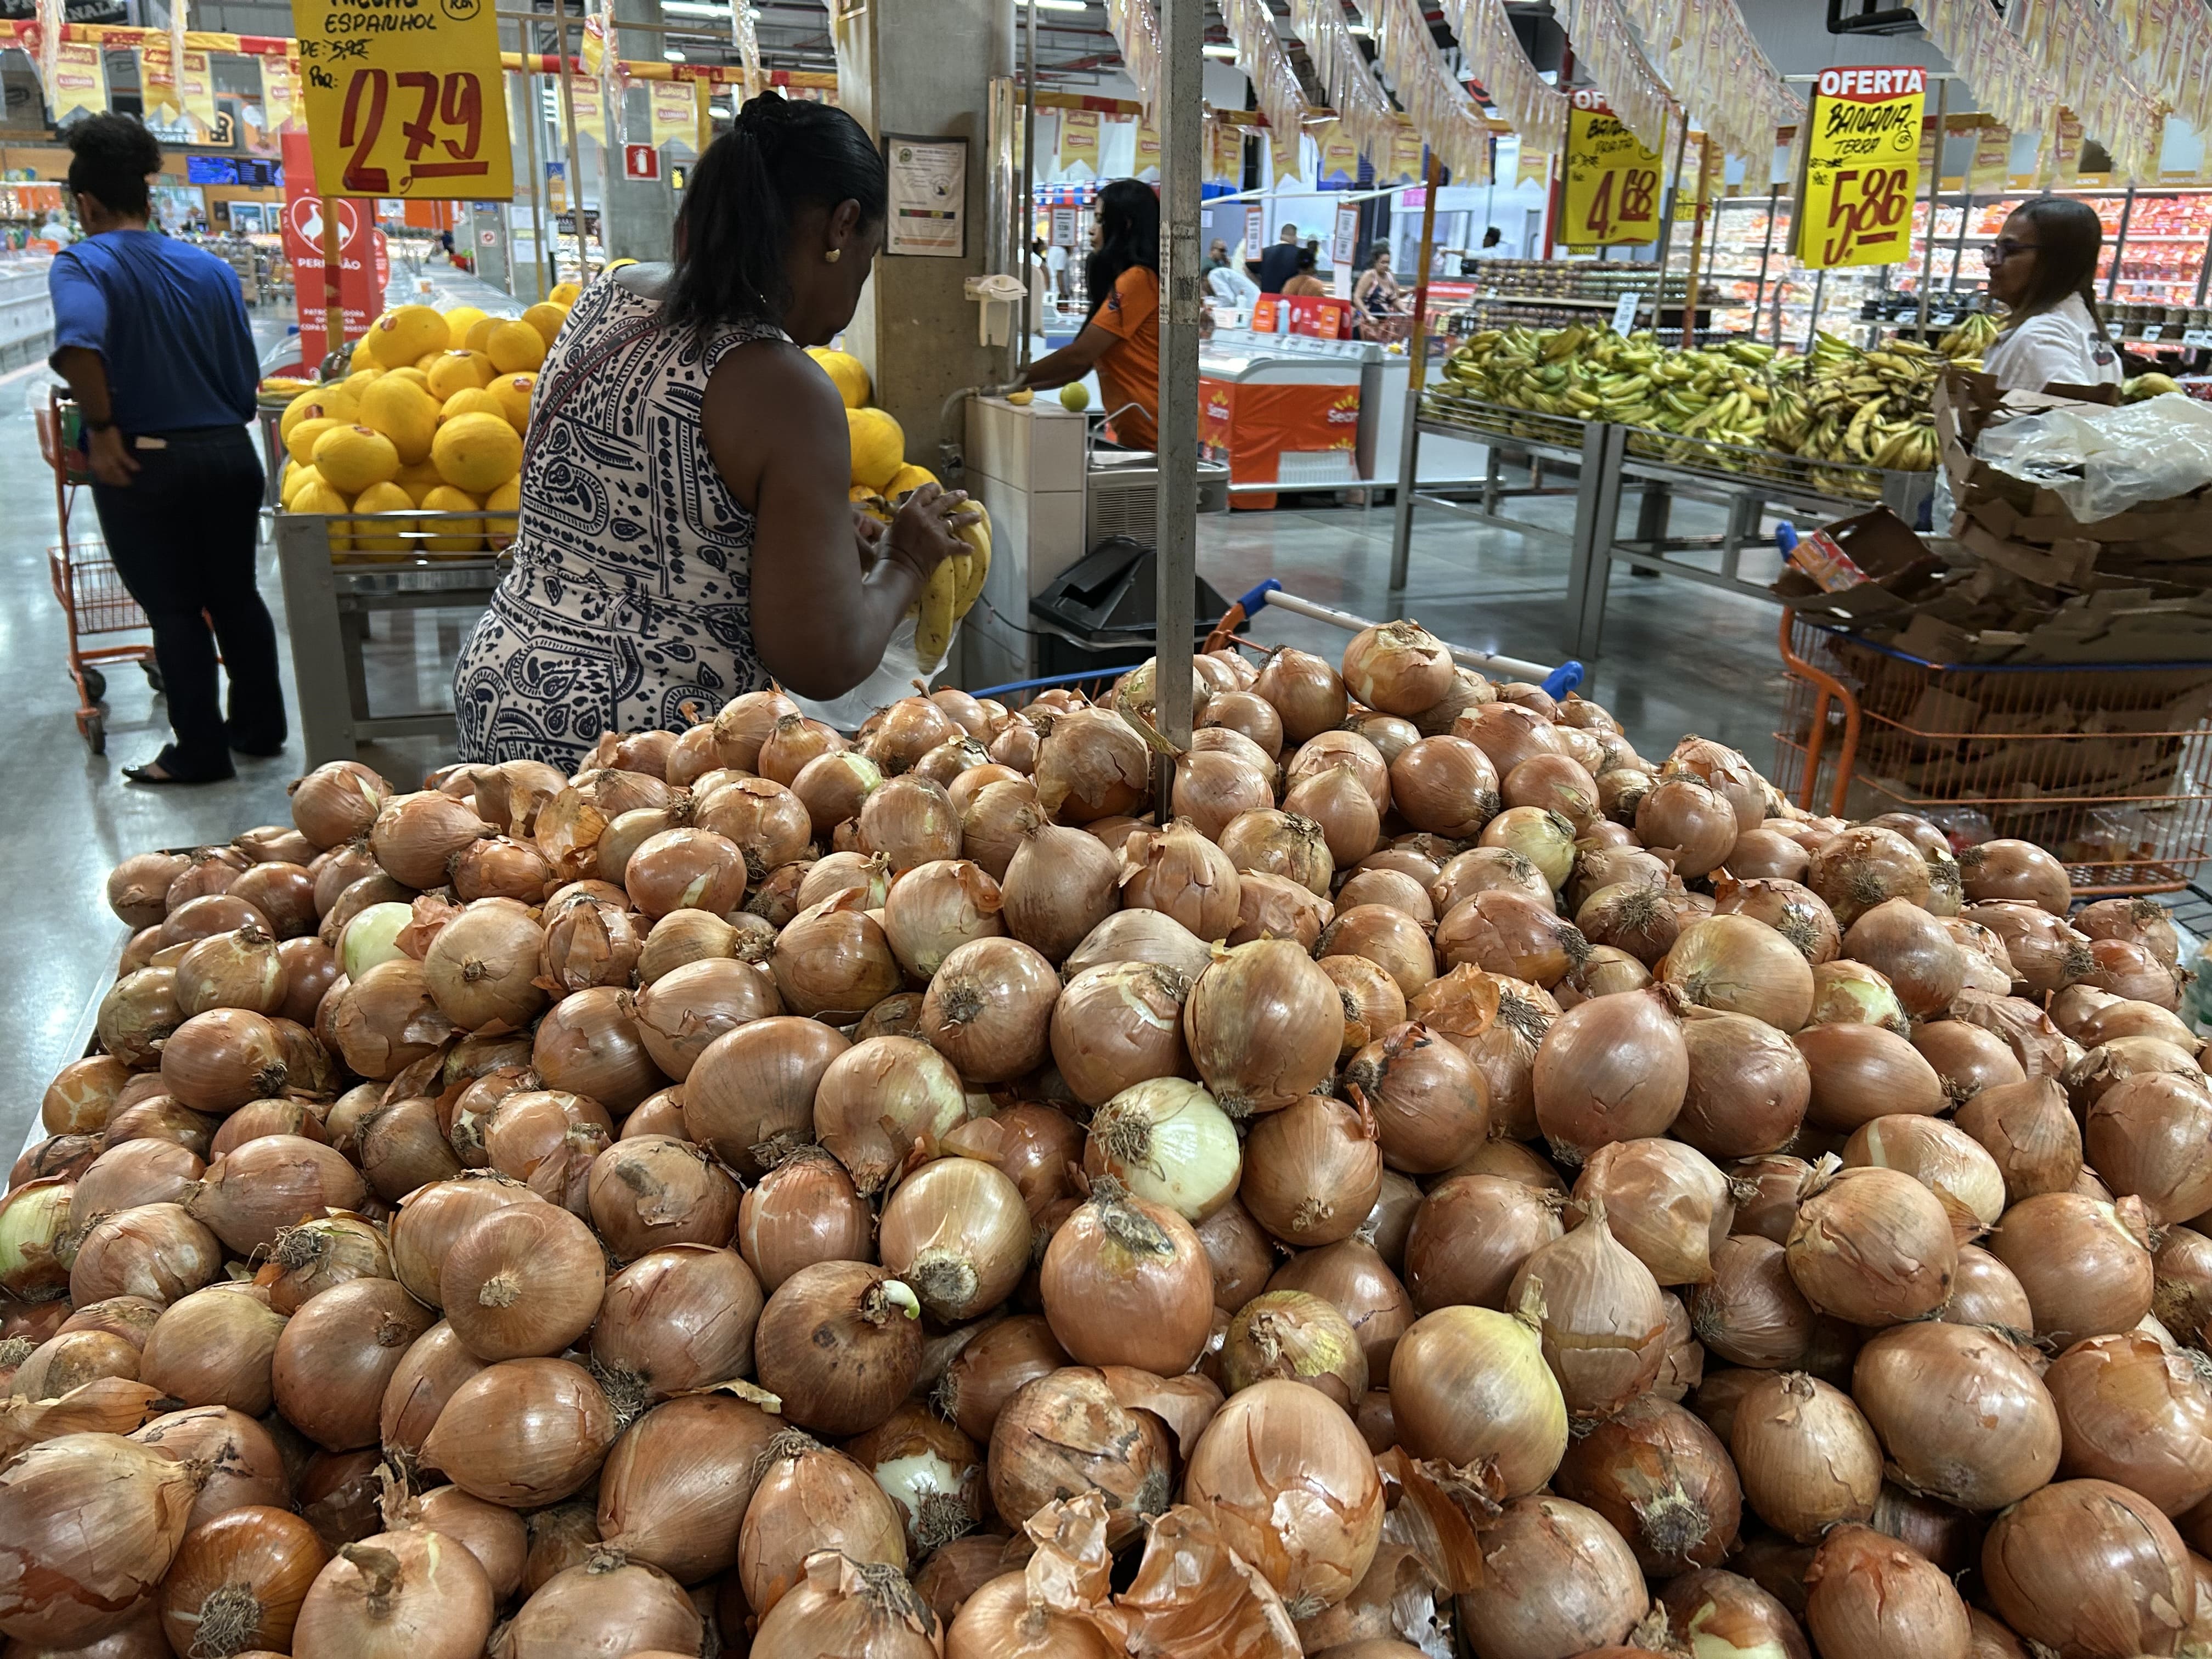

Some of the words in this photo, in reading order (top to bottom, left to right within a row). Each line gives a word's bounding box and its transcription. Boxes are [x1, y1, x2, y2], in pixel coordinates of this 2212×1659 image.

[325, 13, 437, 33] ESPANHOL
[300, 39, 326, 58] DE:
[1820, 69, 1923, 95] OFERTA
[1825, 103, 1913, 138] BANANA
[340, 69, 484, 194] 2,79
[1834, 137, 1881, 155] TERRA
[1823, 168, 1908, 265] 5,86
[298, 257, 361, 270] PERÃO
[1327, 410, 1359, 423] Sear
